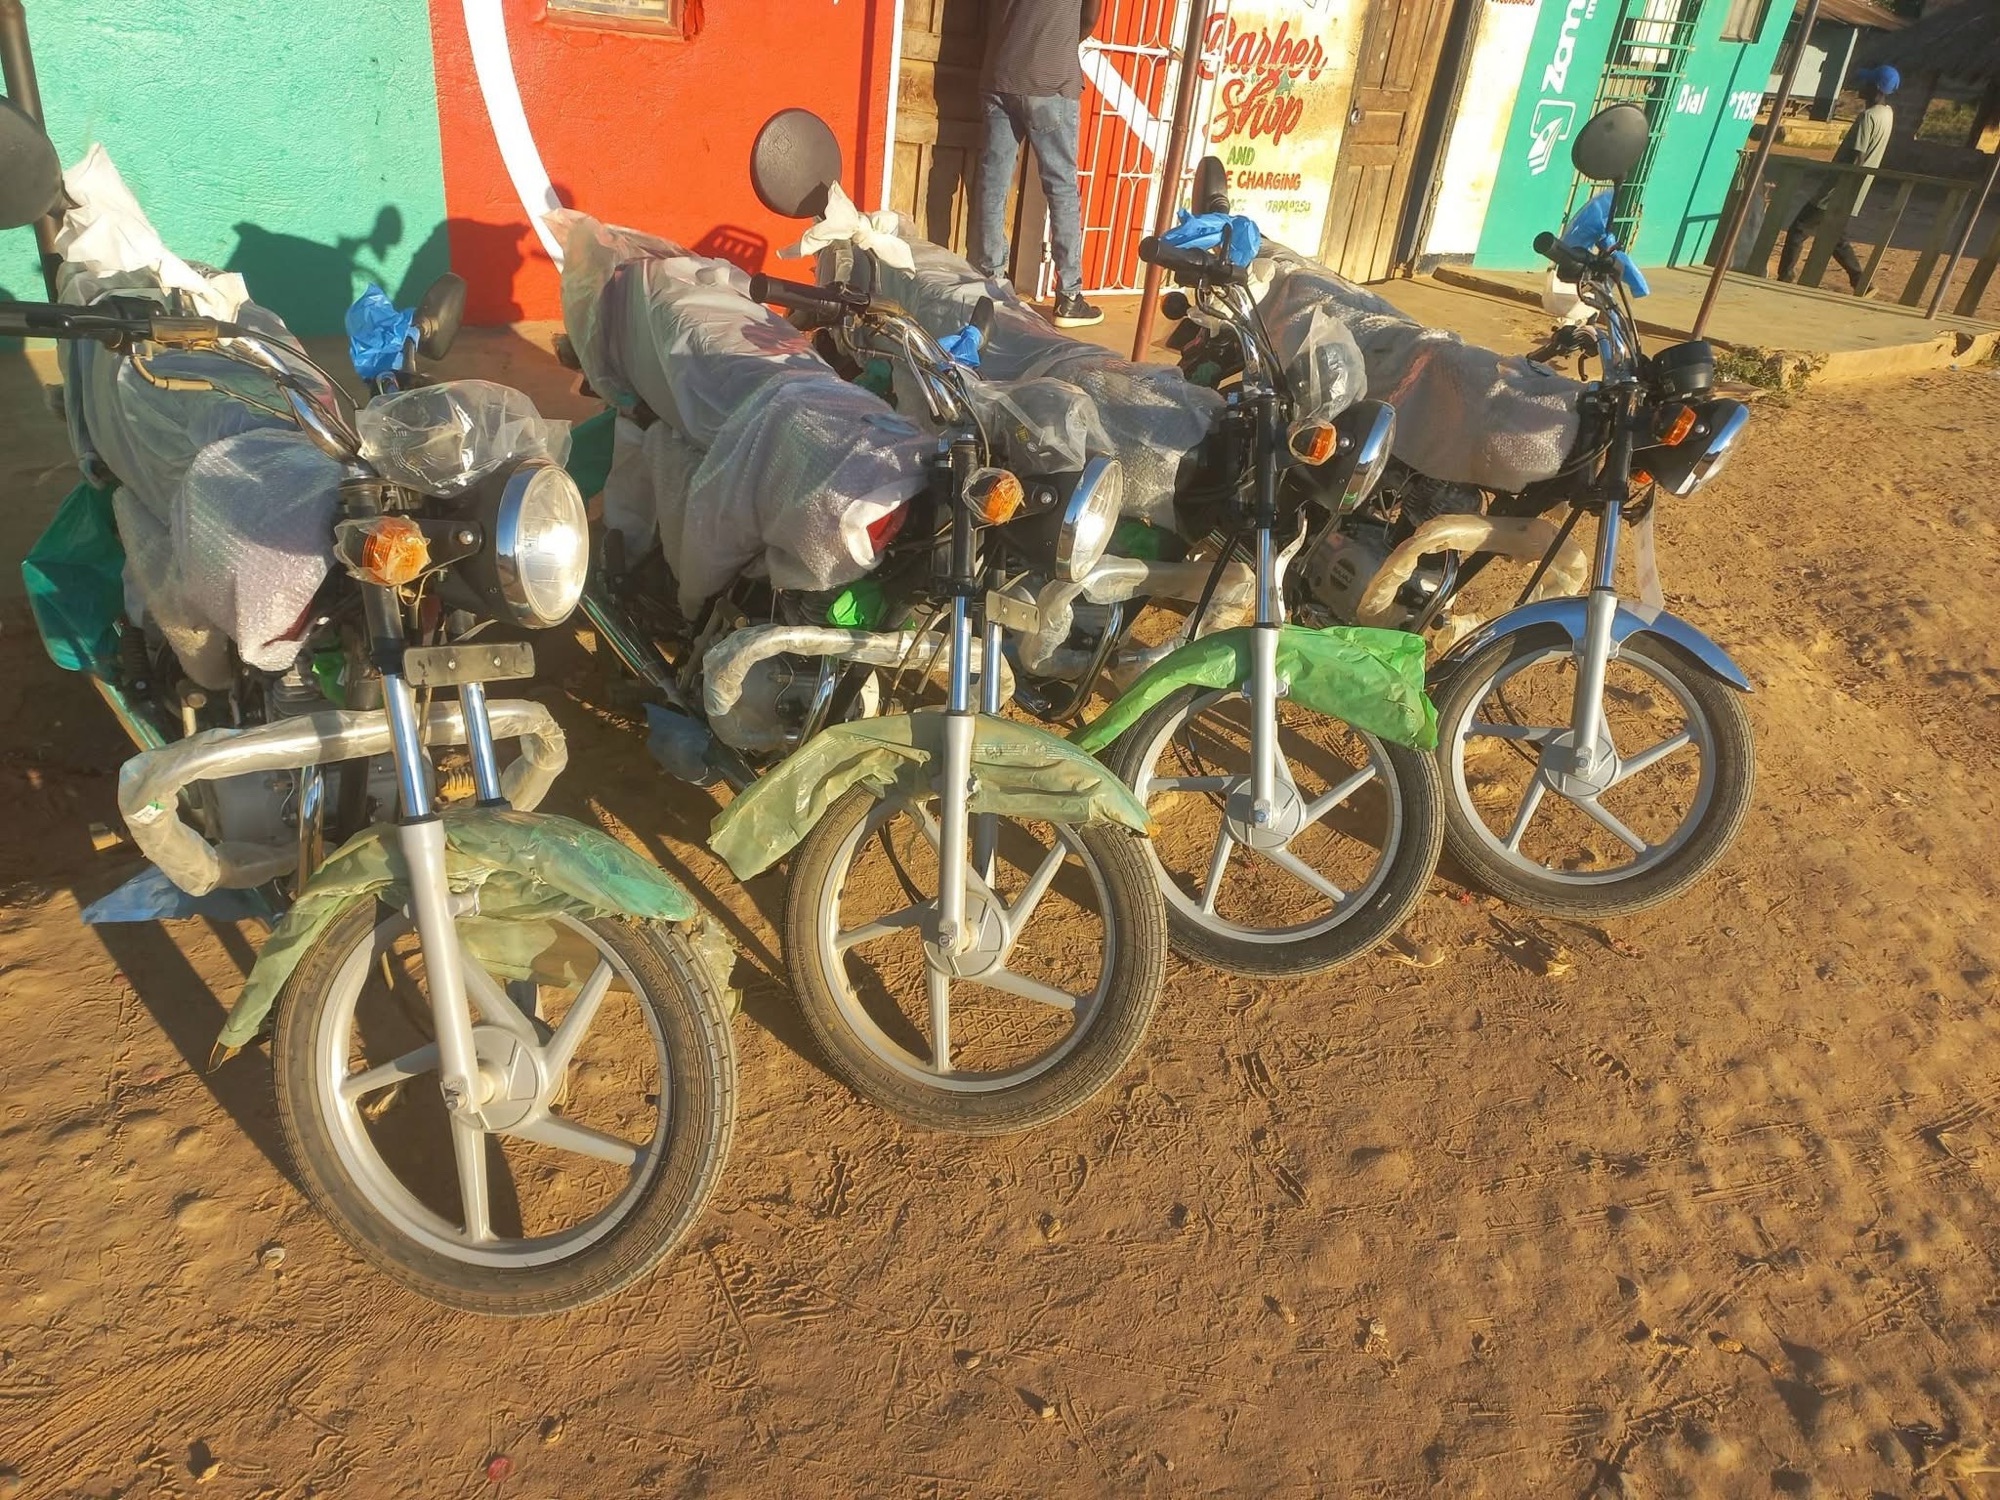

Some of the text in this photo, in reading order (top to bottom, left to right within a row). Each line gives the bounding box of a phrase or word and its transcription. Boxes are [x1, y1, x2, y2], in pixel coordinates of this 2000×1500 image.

[1197, 12, 1328, 81] Barber
[1202, 71, 1304, 146] Shop
[1676, 84, 1709, 115] Dial
[1227, 146, 1256, 165] AND
